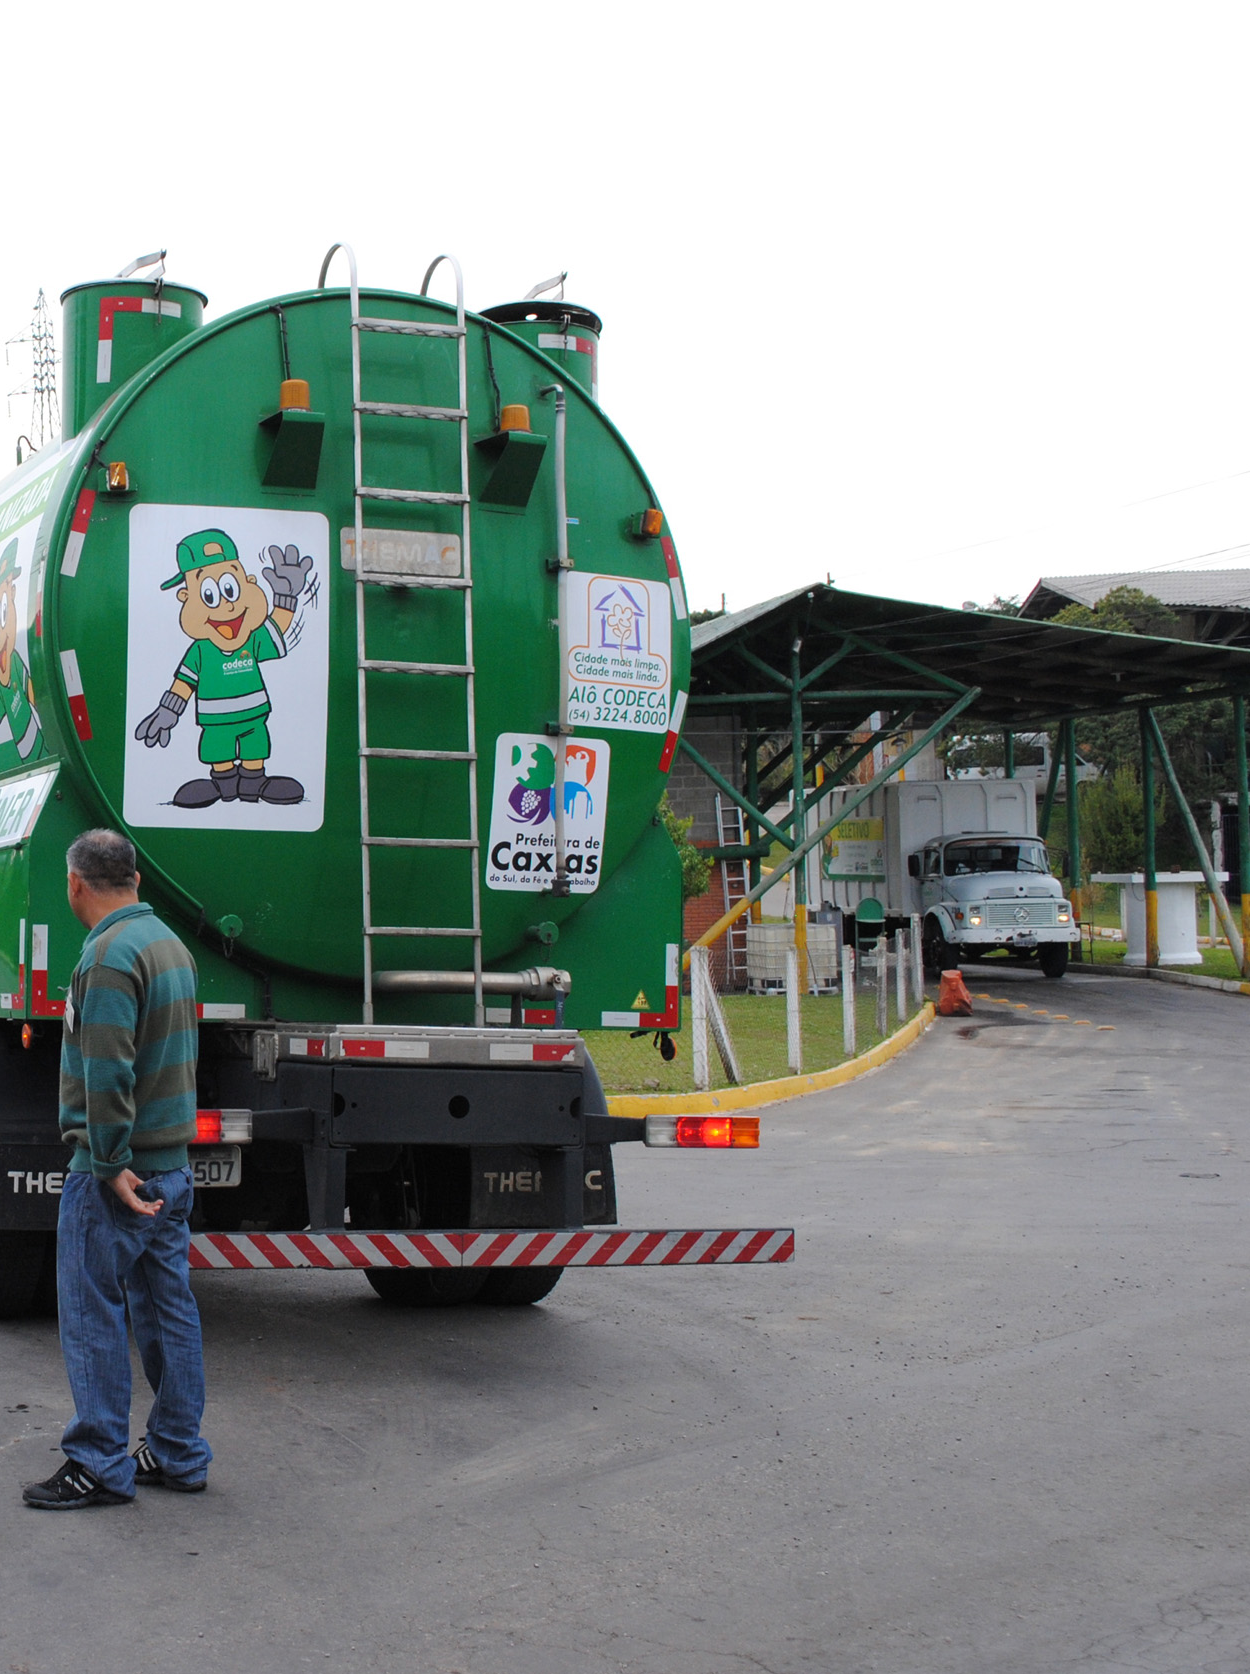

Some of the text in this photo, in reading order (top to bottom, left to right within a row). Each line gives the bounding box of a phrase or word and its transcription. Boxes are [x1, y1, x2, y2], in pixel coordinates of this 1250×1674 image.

[222, 658, 253, 670] codeca
[574, 652, 662, 673] Cidade mais limpa.
[575, 664, 660, 683] Cidade mais linda.
[568, 685, 666, 710] Alô CODECA
[568, 706, 667, 726] (54) 3224.8000
[515, 833, 600, 849] Prefeira de
[491, 841, 598, 875] Caxas
[489, 873, 500, 882] do
[502, 874, 518, 884] Sul,
[520, 875, 531, 884] da
[533, 875, 541, 884] Fé
[569, 877, 596, 886] abalho
[189, 1161, 234, 1182] 507
[8, 1171, 69, 1194] THE
